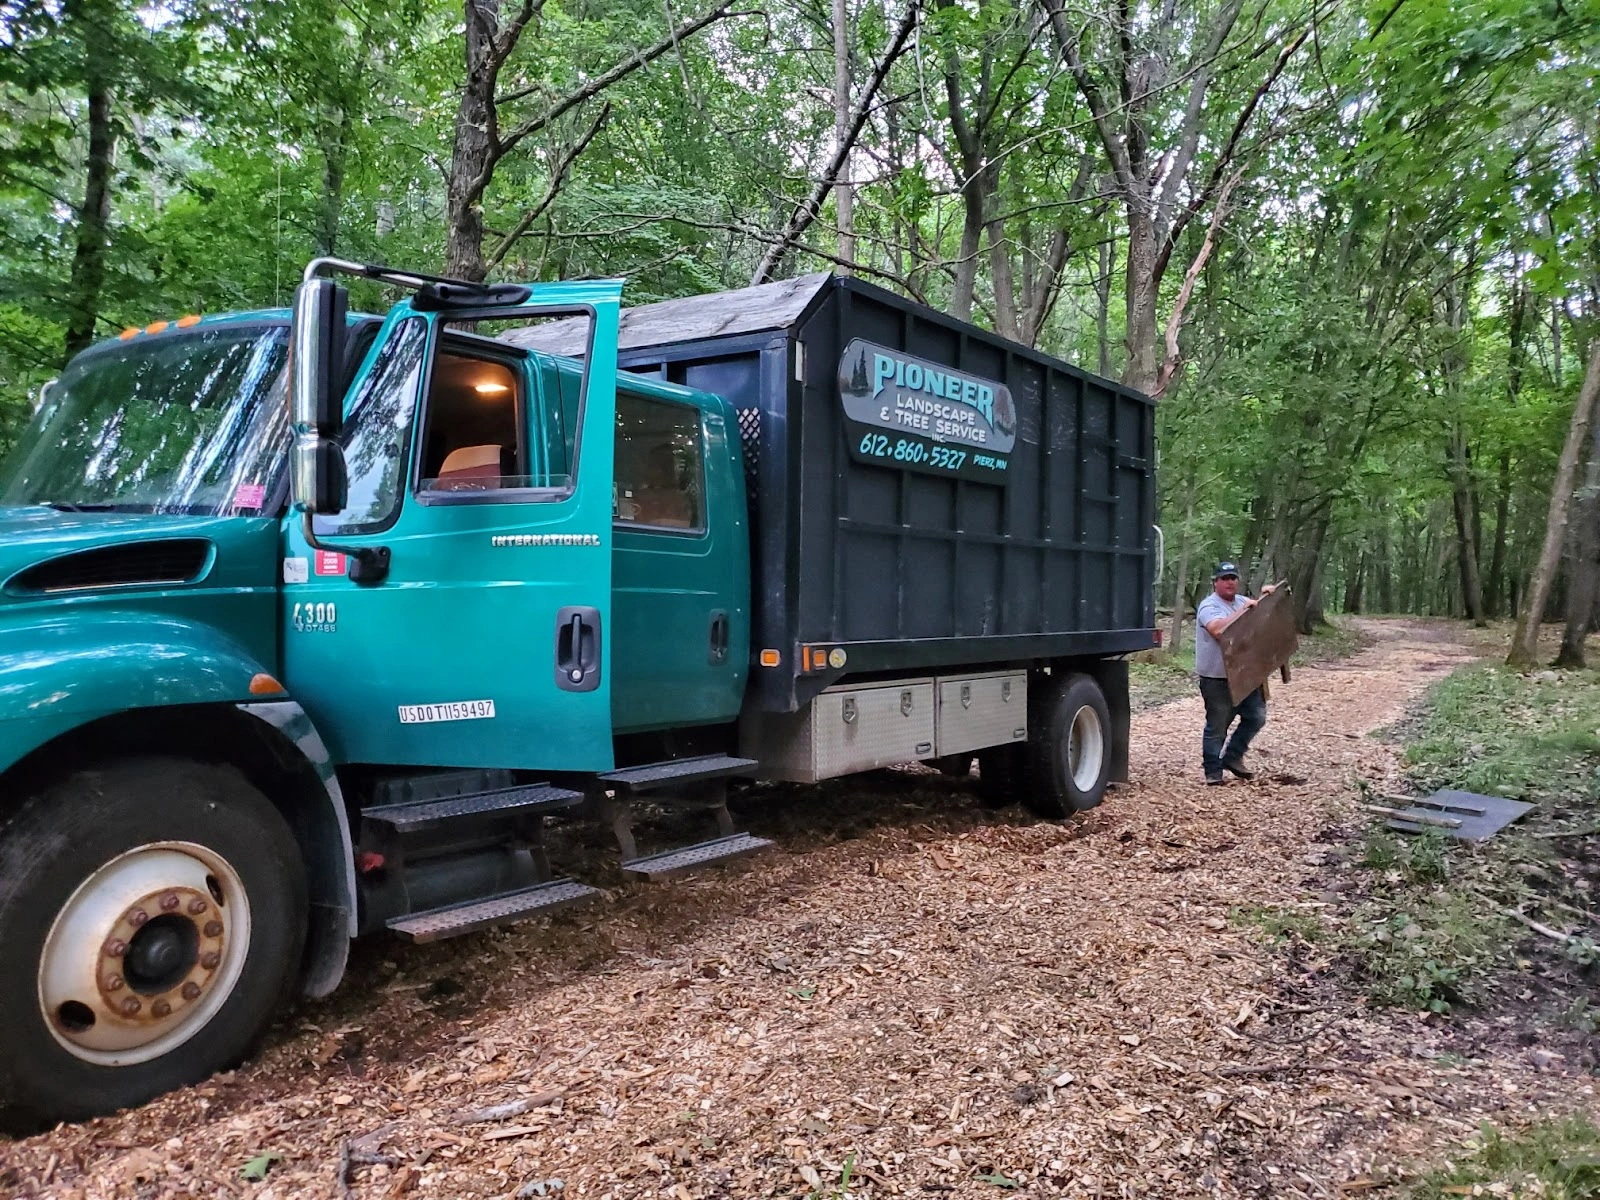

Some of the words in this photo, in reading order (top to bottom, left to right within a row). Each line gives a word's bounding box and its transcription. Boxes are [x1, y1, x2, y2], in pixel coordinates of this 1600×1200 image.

[873, 353, 995, 434] PIONEER
[880, 406, 890, 421] &
[895, 409, 929, 430] TREE
[936, 420, 986, 442] SERVICE
[896, 393, 975, 426] LANDSCAPE
[996, 459, 1007, 470] MN
[491, 534, 601, 547] INTERNATIONAL
[292, 602, 336, 632] 4300
